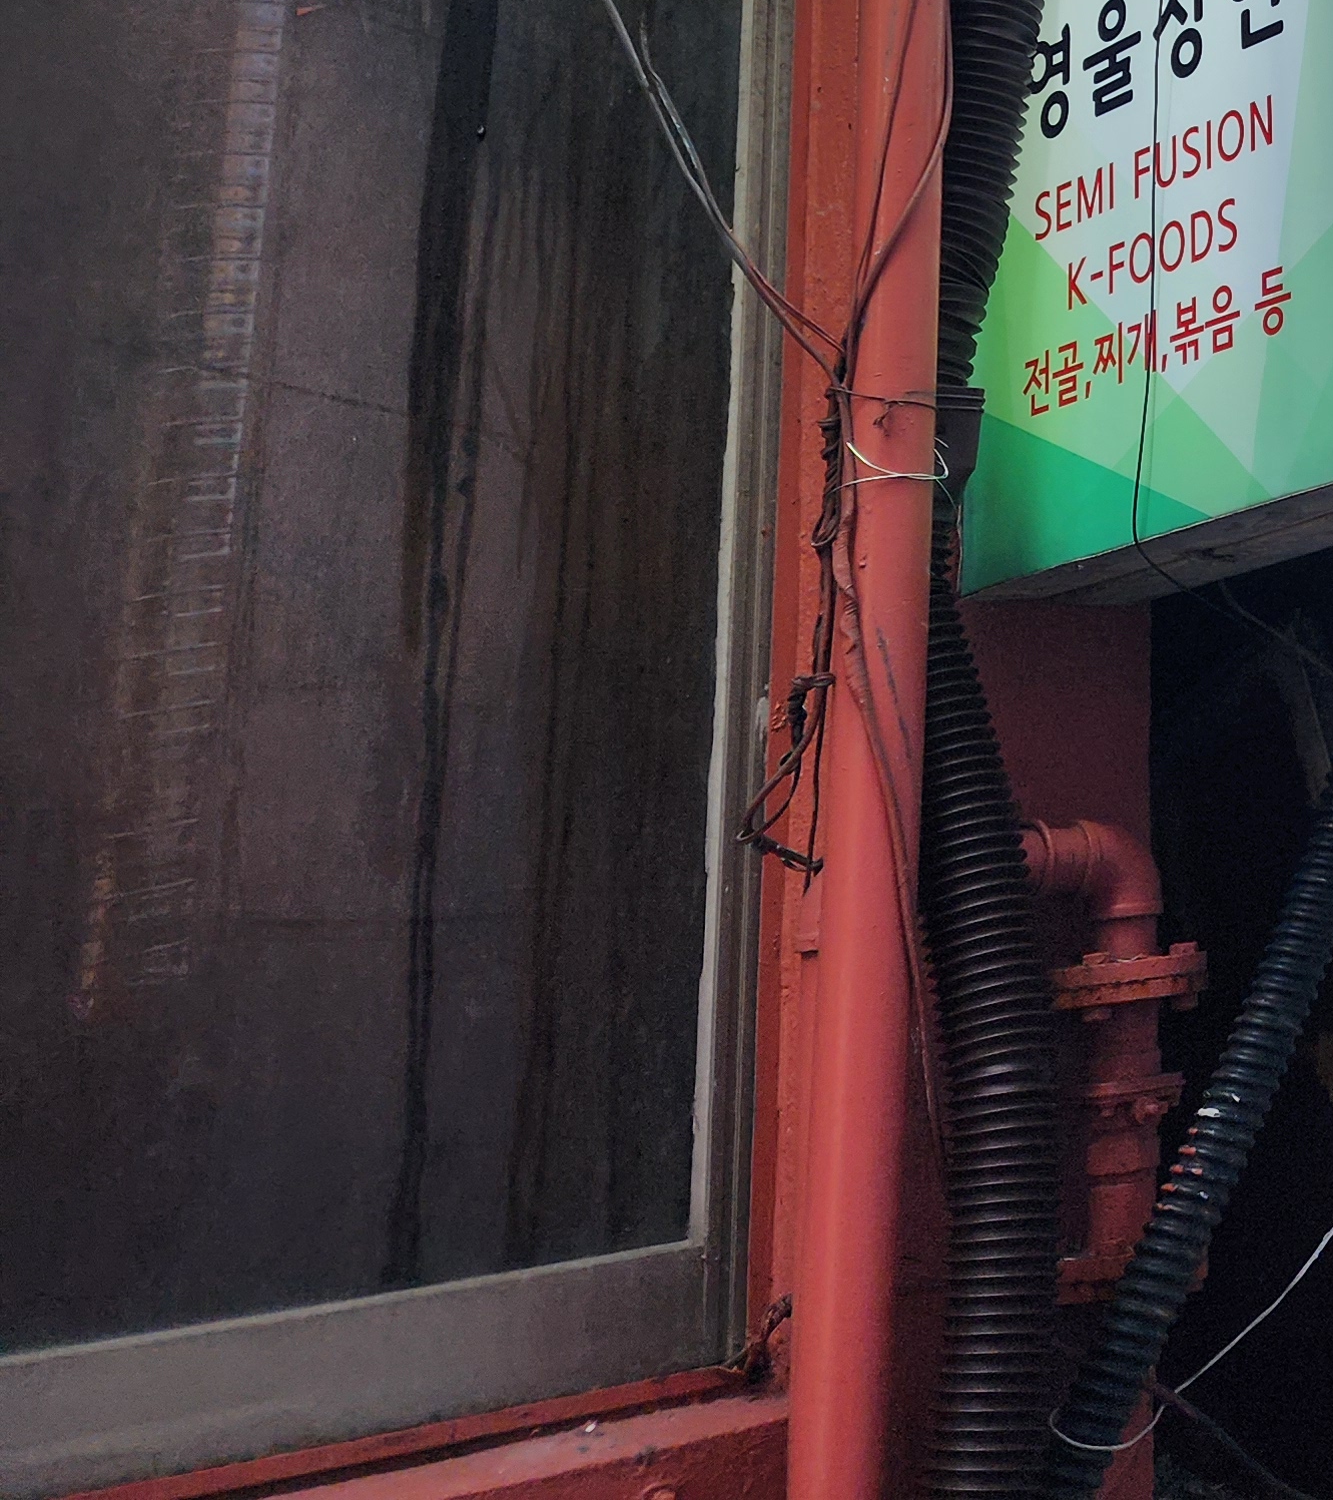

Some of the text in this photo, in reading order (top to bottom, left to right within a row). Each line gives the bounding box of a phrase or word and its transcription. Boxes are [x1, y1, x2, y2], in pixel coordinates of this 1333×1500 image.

[1034, 94, 1274, 241] SEMI FUSION
[1067, 197, 1238, 310] K-FOODS
[1253, 265, 1292, 336] 등
